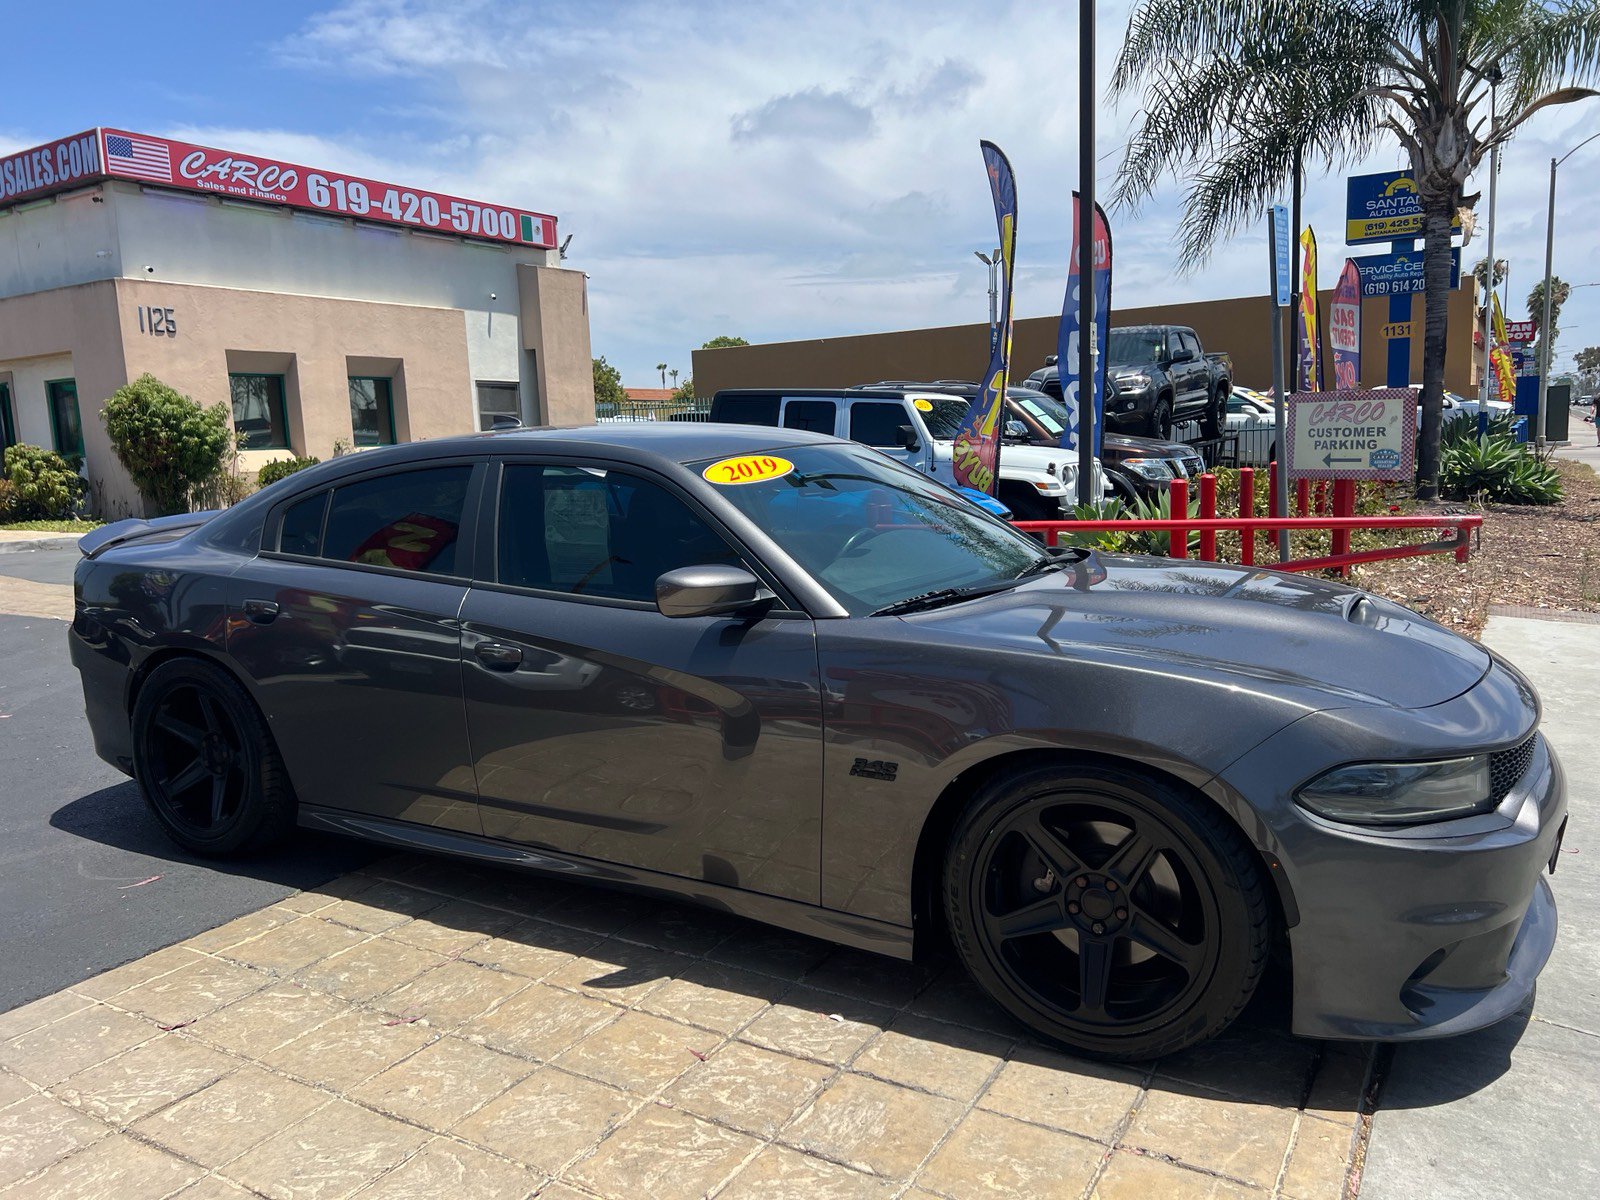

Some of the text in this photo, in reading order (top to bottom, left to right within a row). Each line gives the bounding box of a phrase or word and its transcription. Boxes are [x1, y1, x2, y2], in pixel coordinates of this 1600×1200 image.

[179, 151, 299, 192] CARCO
[197, 179, 287, 201] Sales and Finance
[306, 173, 516, 240] 619-420-5700
[1366, 195, 1421, 210] SANTA
[1369, 208, 1397, 217] AUTO
[1364, 221, 1387, 232] (619)
[1389, 218, 1410, 228] 426
[1359, 263, 1402, 276] ERVICE
[1371, 272, 1393, 281] Quality
[1394, 271, 1408, 279] Auto
[1364, 281, 1390, 295] (619)
[1392, 280, 1410, 293] 614
[137, 305, 177, 337] 1125
[1383, 324, 1412, 337] 1131
[1309, 401, 1386, 426] CARCO
[1308, 426, 1387, 438] CUSTOMER
[1314, 439, 1378, 450] PARKING
[722, 457, 777, 482] 2019
